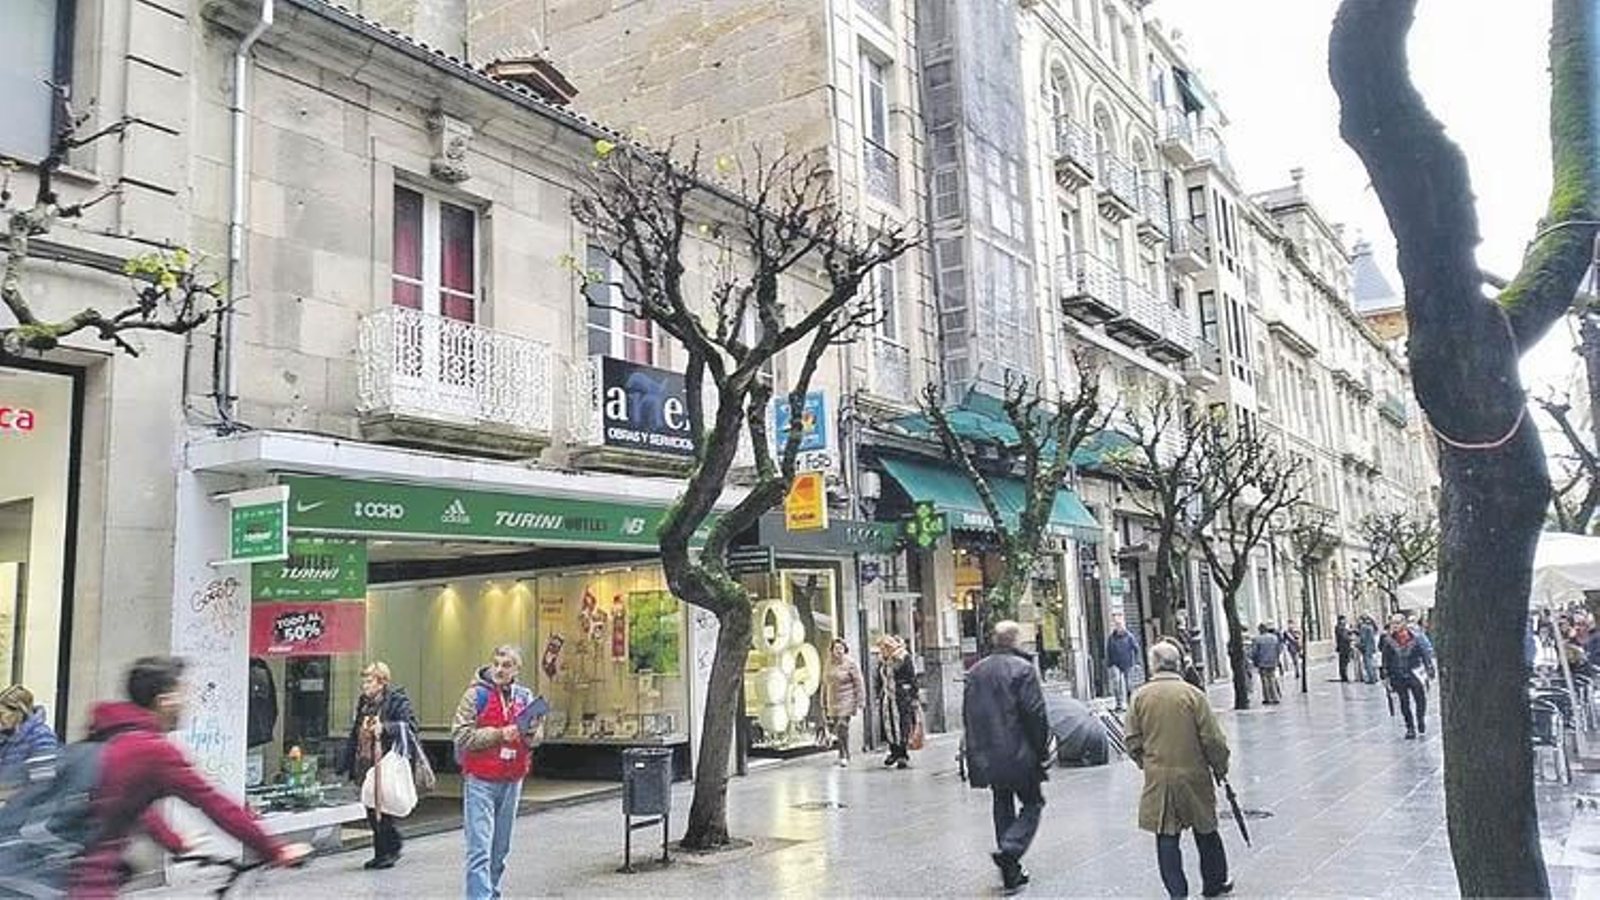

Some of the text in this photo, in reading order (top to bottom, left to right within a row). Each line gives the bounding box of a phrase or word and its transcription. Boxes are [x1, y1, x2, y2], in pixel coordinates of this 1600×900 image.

[608, 428, 641, 441] OBRAS
[641, 432, 649, 443] Y
[494, 511, 562, 529] TURINI
[277, 612, 321, 629] TODO AL
[284, 621, 320, 641] 50%
